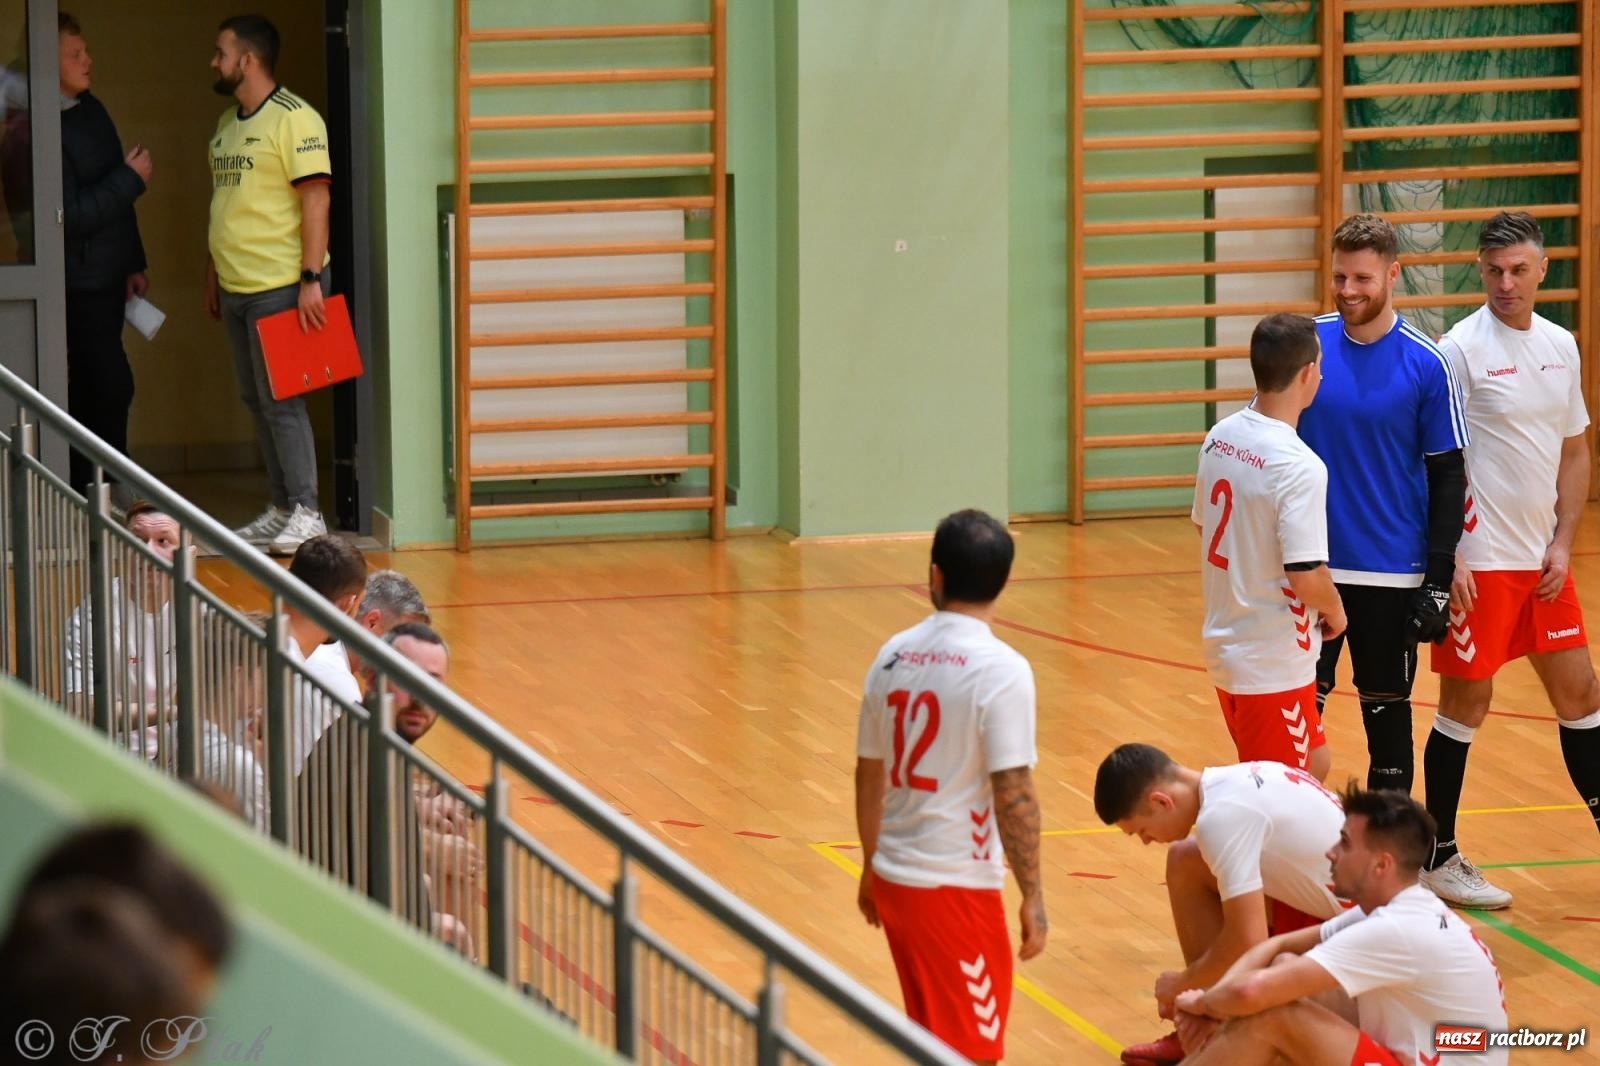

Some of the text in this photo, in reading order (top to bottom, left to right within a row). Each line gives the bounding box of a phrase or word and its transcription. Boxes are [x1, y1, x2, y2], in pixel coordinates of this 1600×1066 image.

[1486, 365, 1518, 377] hummel
[1215, 440, 1265, 470] PRD KÜHN
[1207, 478, 1233, 571] 2
[1547, 625, 1579, 640] hummel
[887, 690, 940, 793] 12
